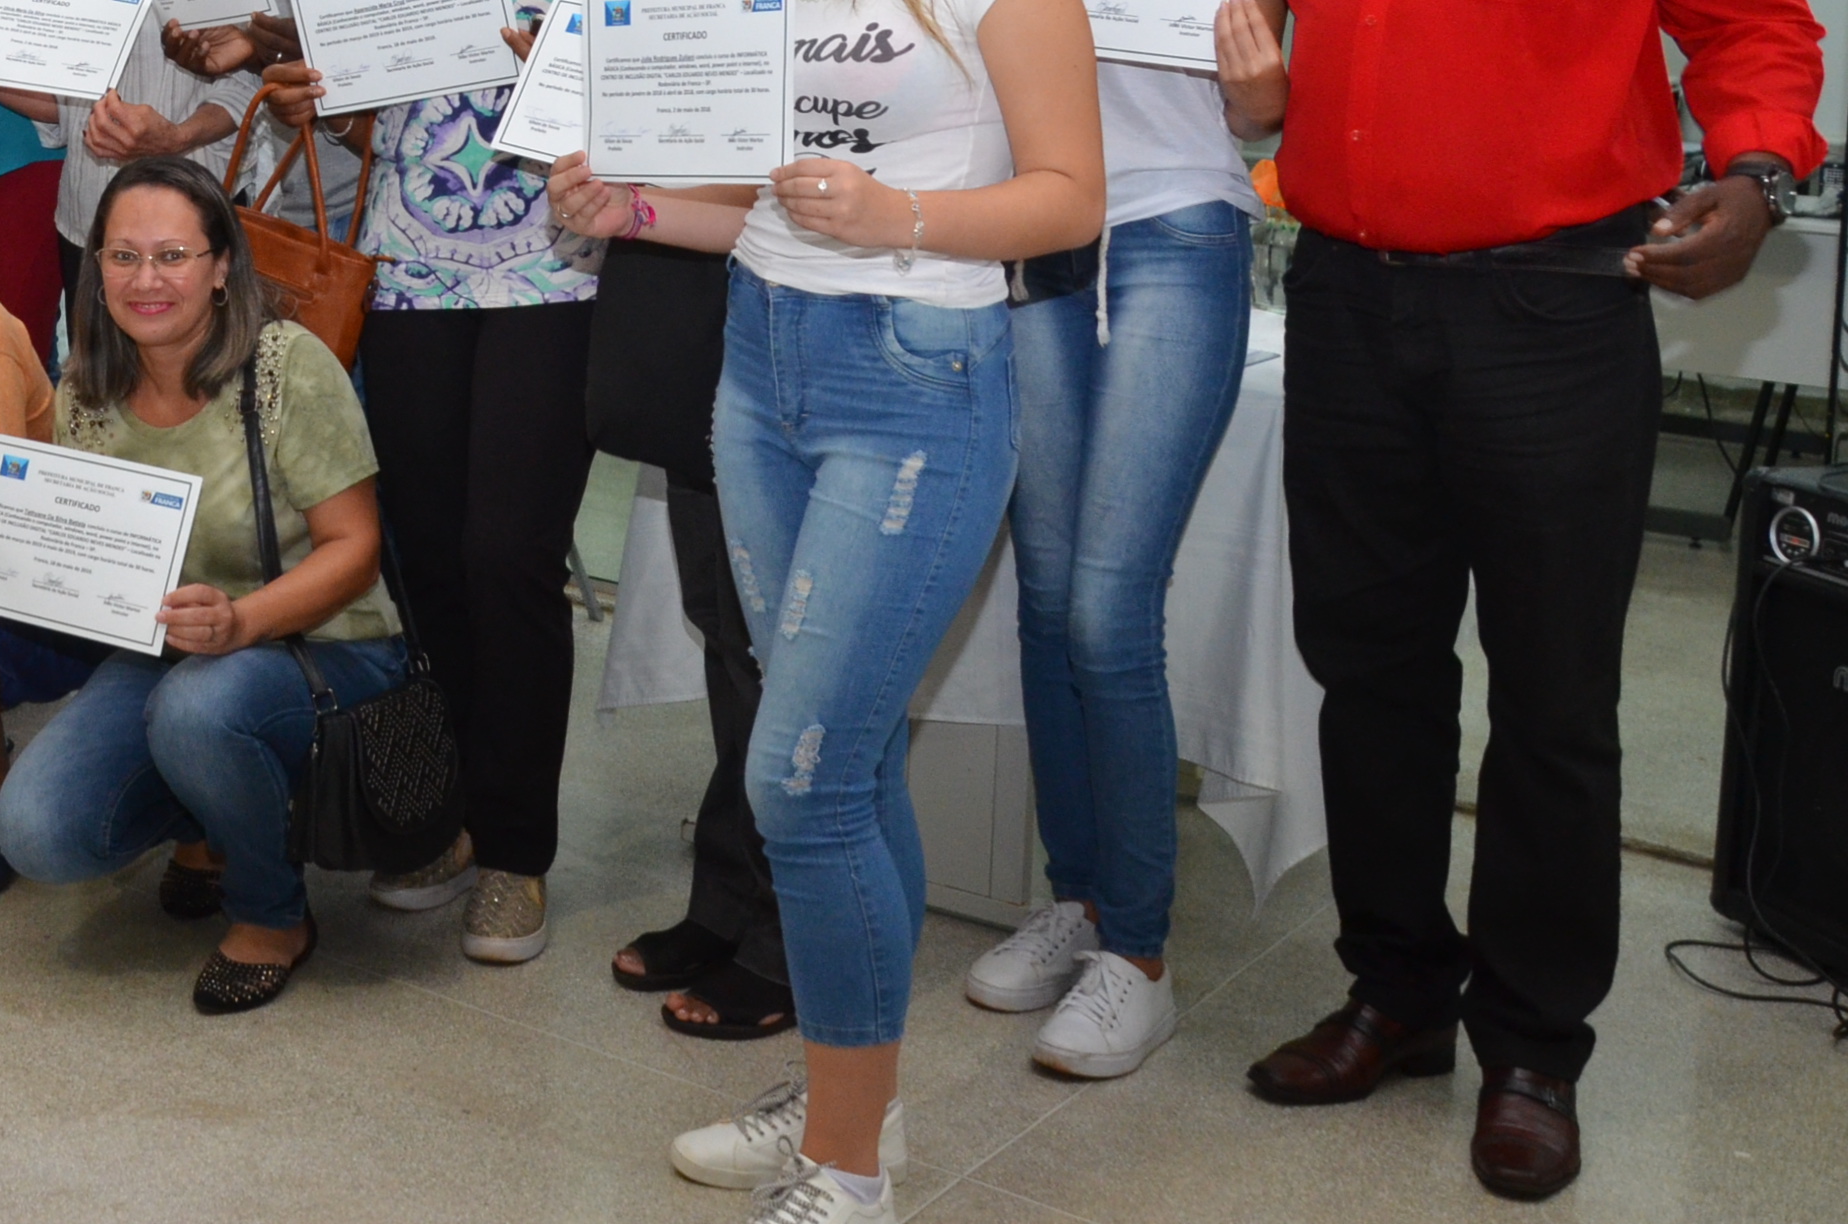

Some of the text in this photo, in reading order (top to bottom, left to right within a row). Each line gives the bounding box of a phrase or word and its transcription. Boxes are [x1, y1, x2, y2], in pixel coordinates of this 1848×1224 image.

[755, 1, 780, 10] FRANCA
[663, 30, 707, 41] CERTIFICADO
[54, 495, 100, 513] CERTIFICADO
[154, 497, 180, 508] FRANCA
